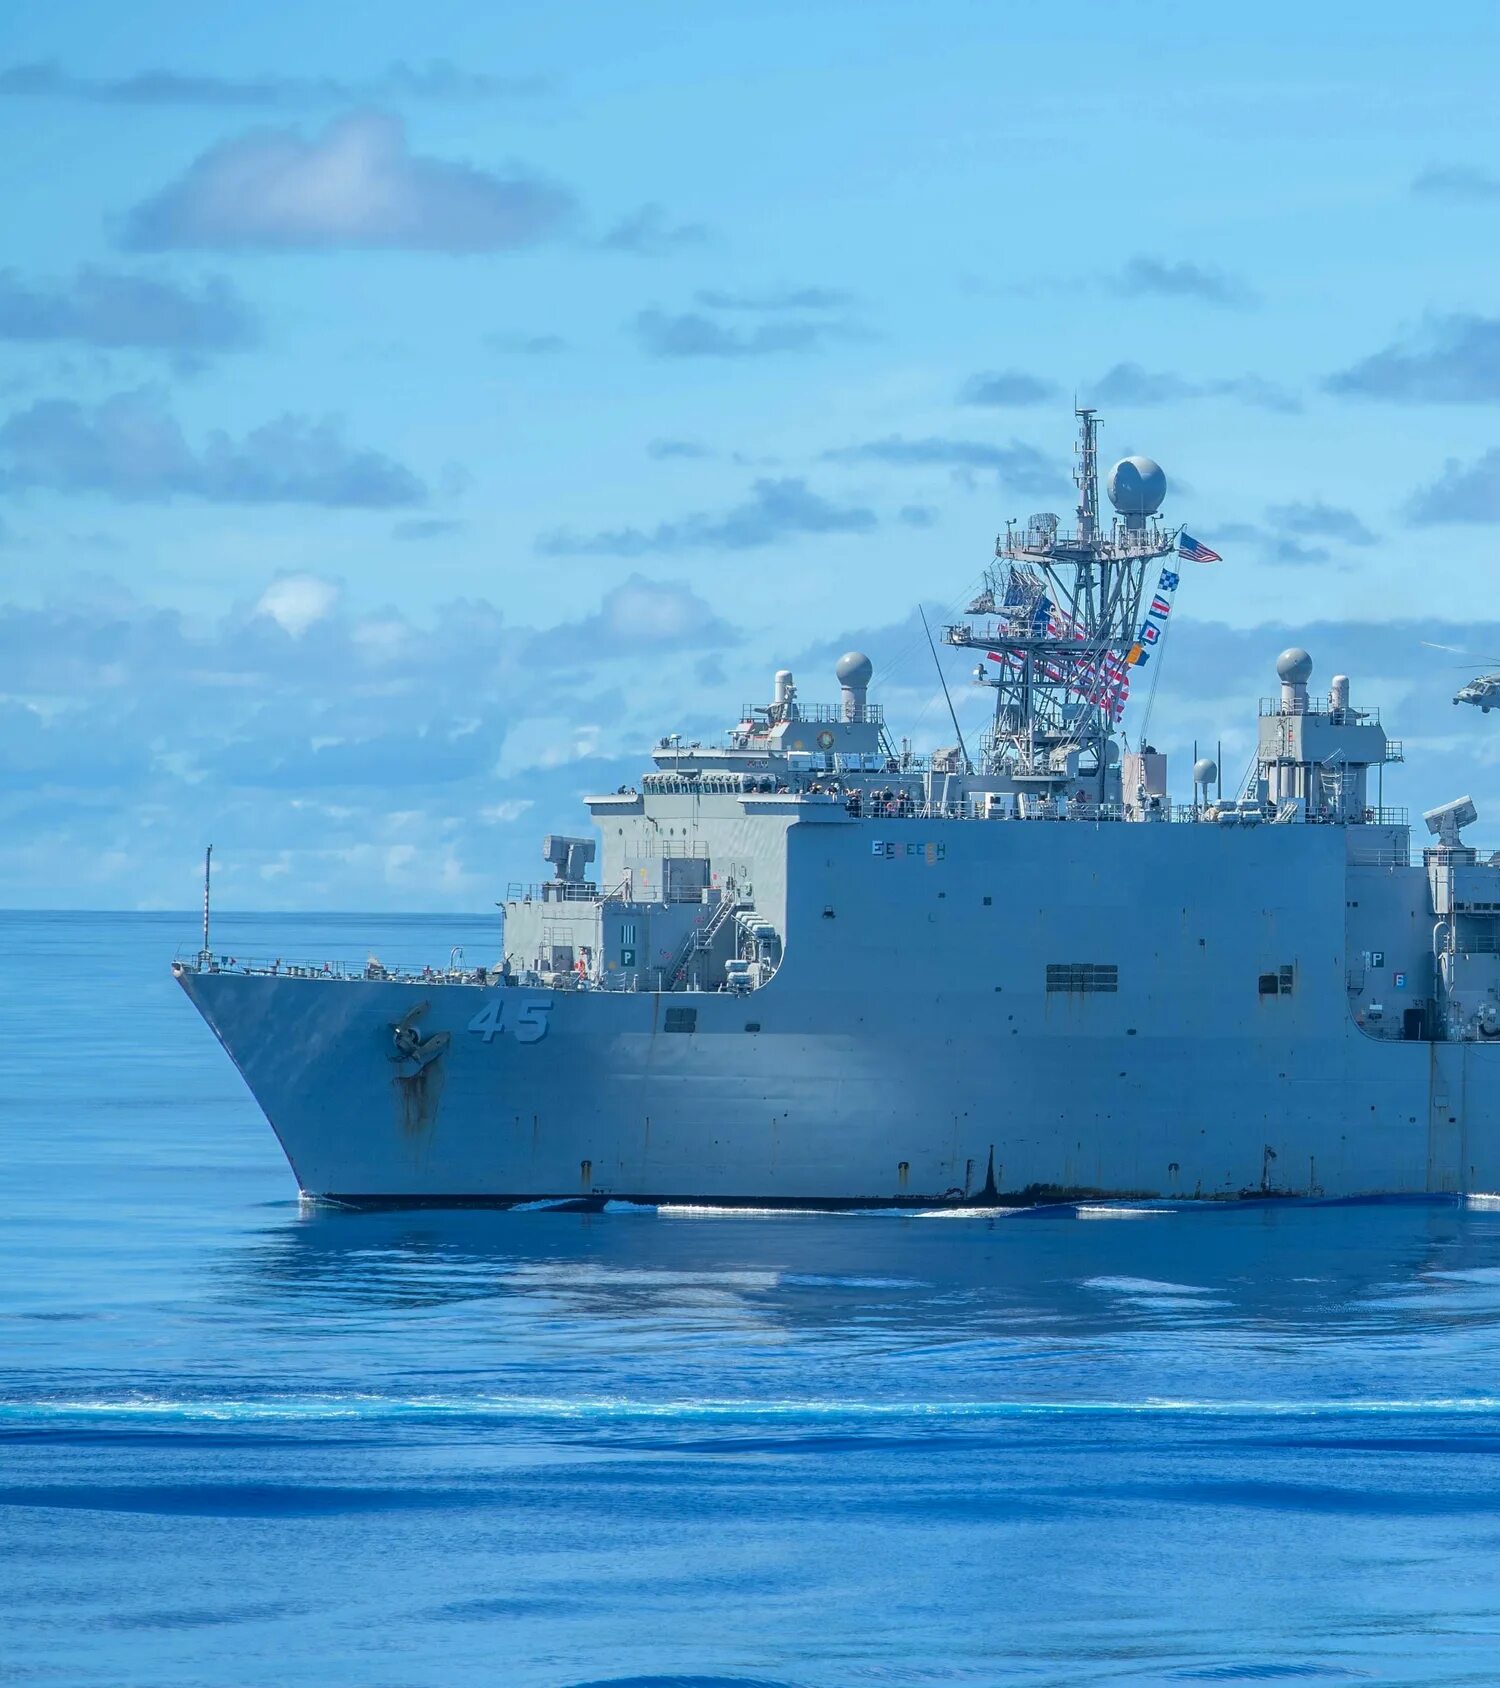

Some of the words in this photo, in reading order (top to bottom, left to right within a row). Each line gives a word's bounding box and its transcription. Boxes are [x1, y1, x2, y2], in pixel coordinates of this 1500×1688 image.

[624, 951, 632, 964] P
[1373, 953, 1383, 966] P
[467, 999, 554, 1045] 45
